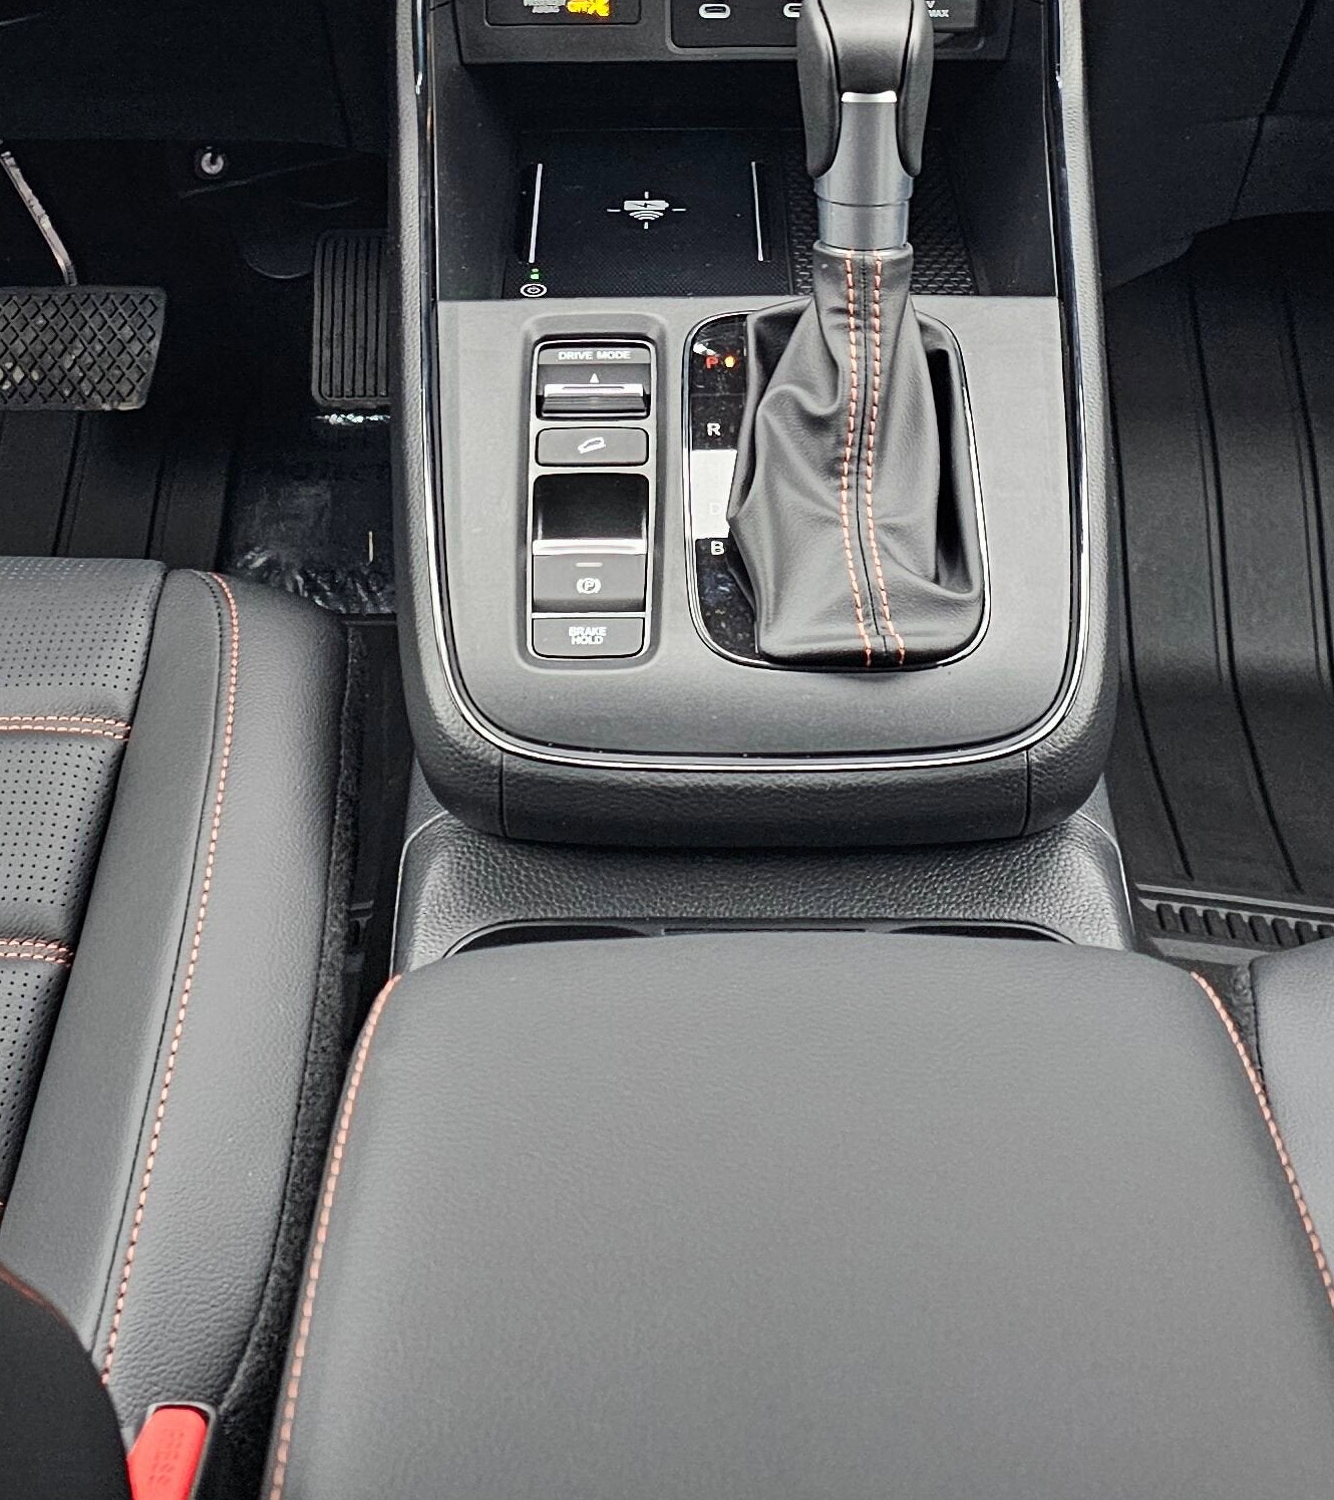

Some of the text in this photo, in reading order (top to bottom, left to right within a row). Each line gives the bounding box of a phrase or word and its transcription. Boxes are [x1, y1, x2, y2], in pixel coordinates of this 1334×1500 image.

[557, 350, 631, 360] DRIVE MODE
[705, 356, 718, 369] P
[707, 422, 722, 437] R
[709, 501, 723, 516] D
[710, 540, 724, 556] B
[568, 626, 608, 637] BRAKE
[571, 635, 605, 646] HOLD
